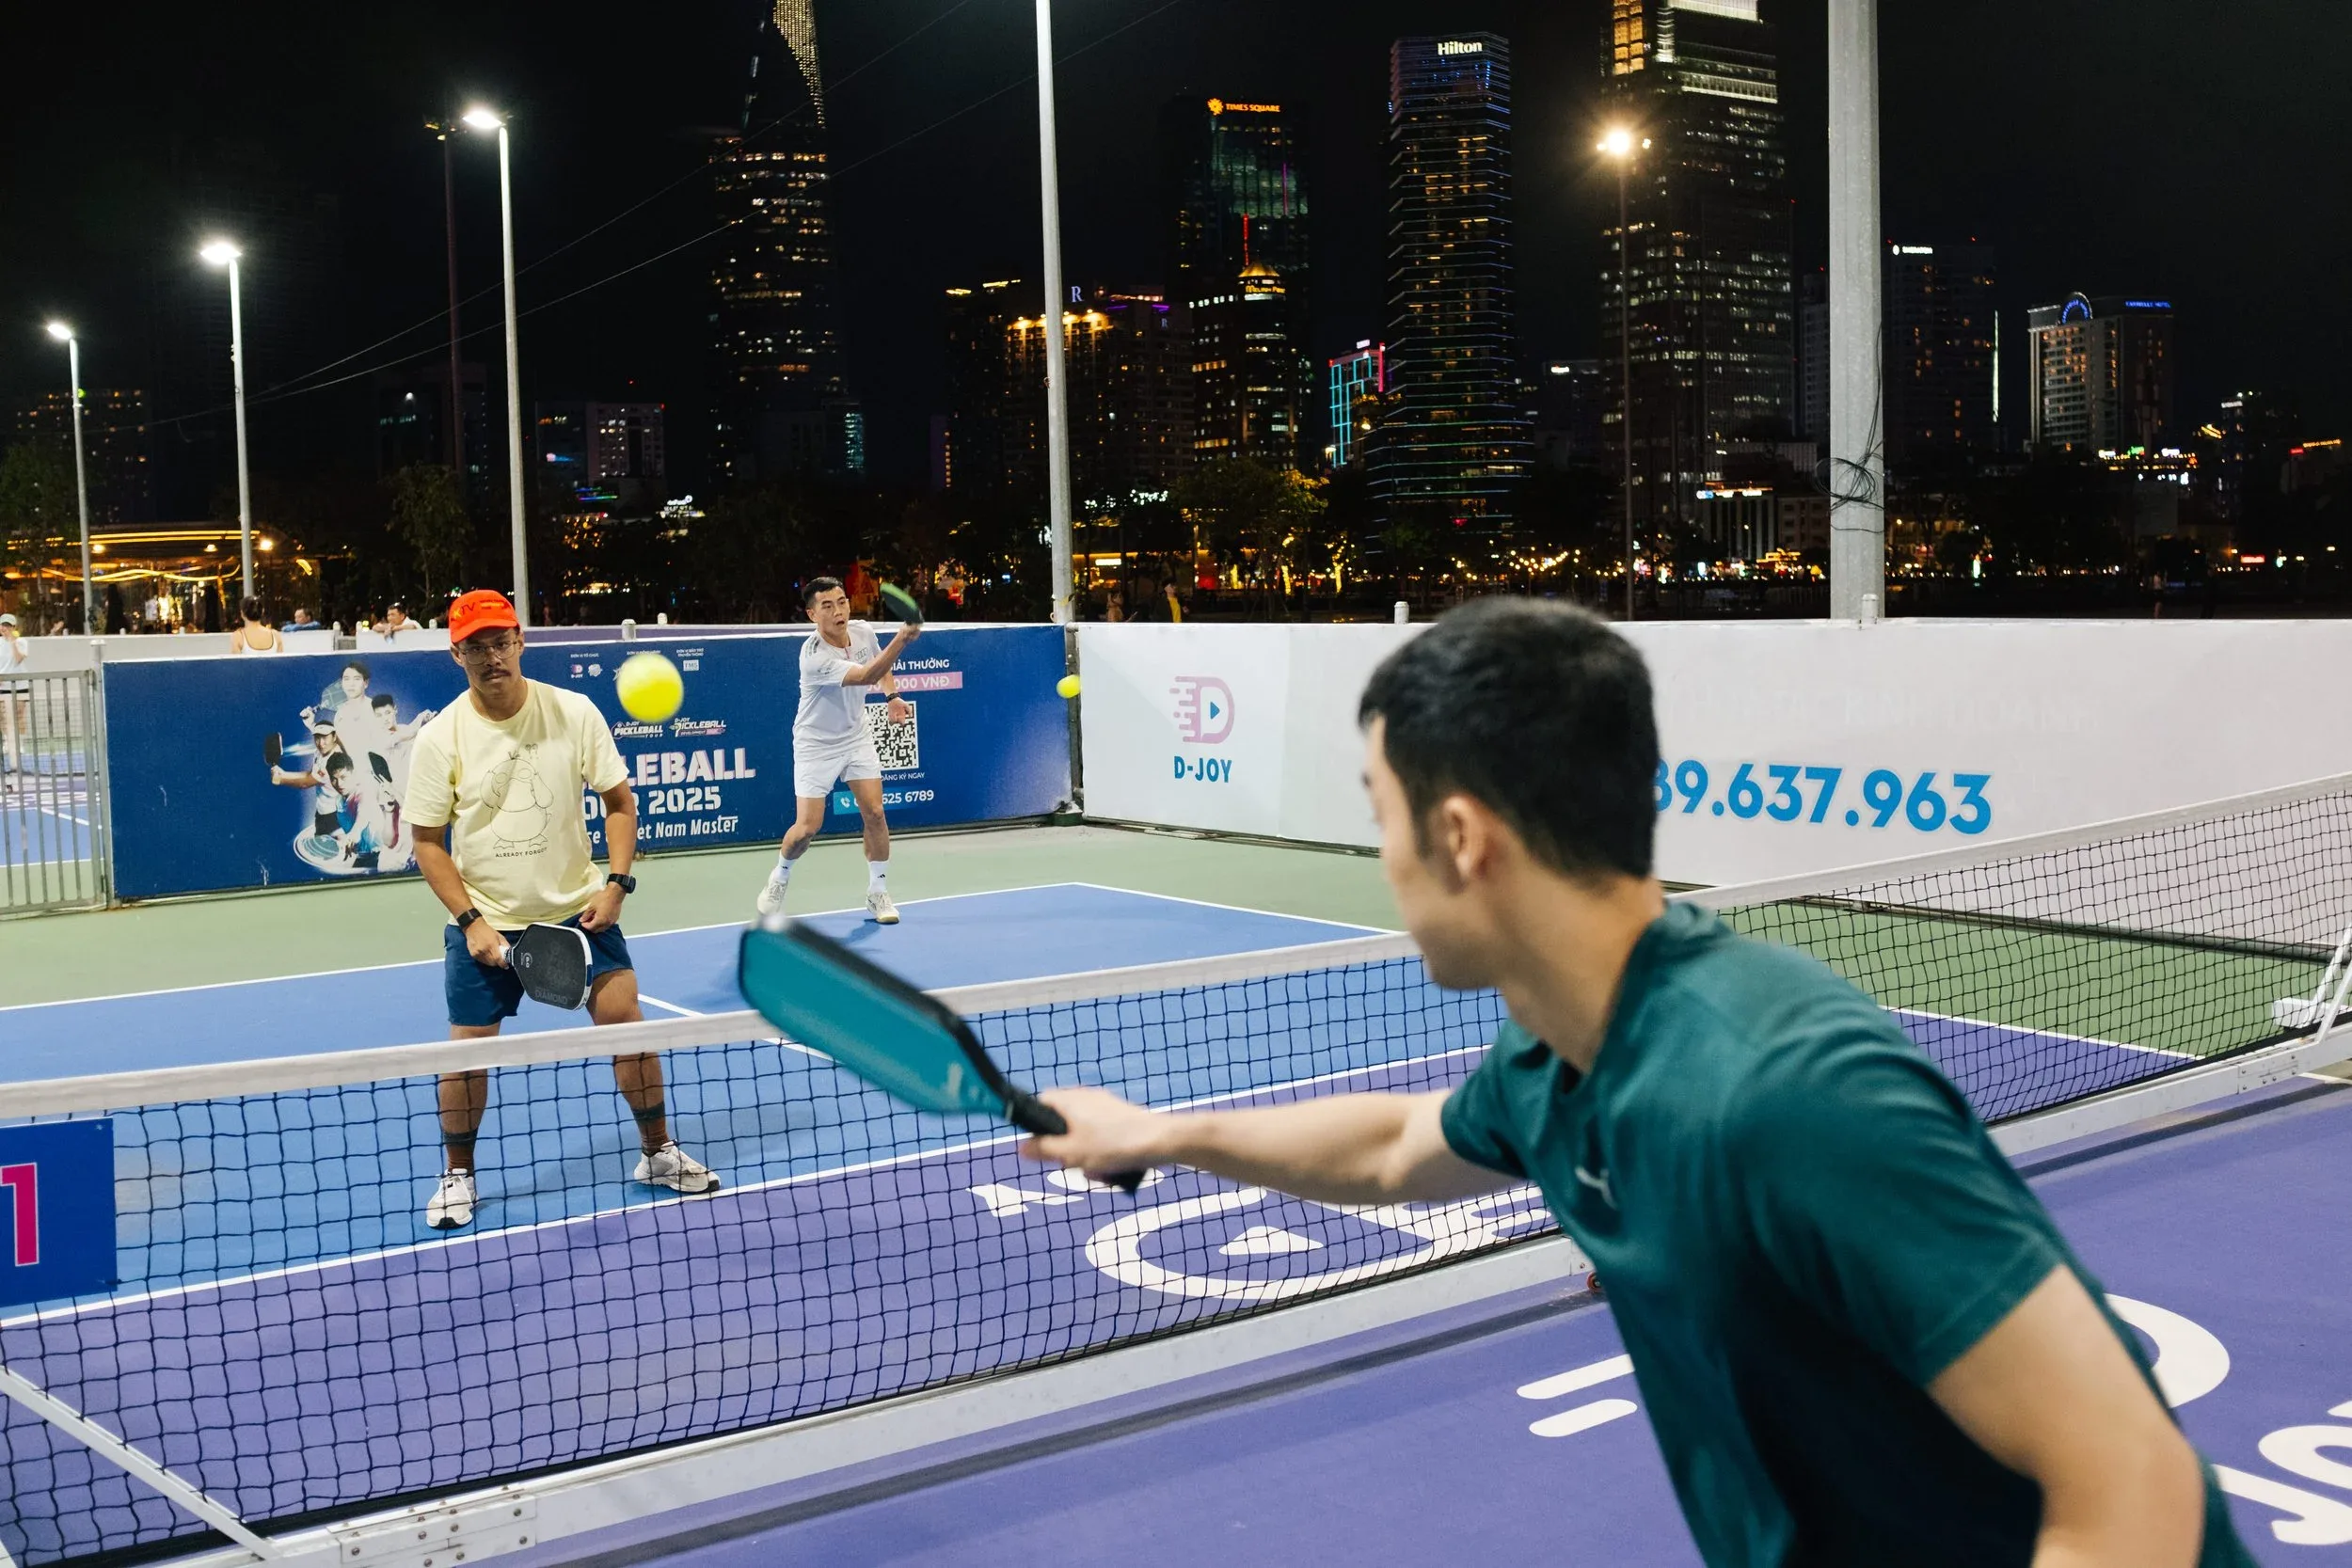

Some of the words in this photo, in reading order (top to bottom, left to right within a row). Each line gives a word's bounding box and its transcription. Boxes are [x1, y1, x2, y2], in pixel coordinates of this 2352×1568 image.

[1437, 40, 1483, 55] Hilton
[1226, 103, 1249, 111] TIMES
[1249, 103, 1280, 112] SQUARE
[1071, 285, 1083, 303] R
[1173, 755, 1232, 783] D-JOY
[648, 785, 722, 815] 2025
[904, 789, 935, 802] 6789
[655, 821, 687, 838] Nam
[691, 815, 739, 835] Master
[524, 847, 548, 856] FORGOT
[0, 1162, 40, 1267] 1
